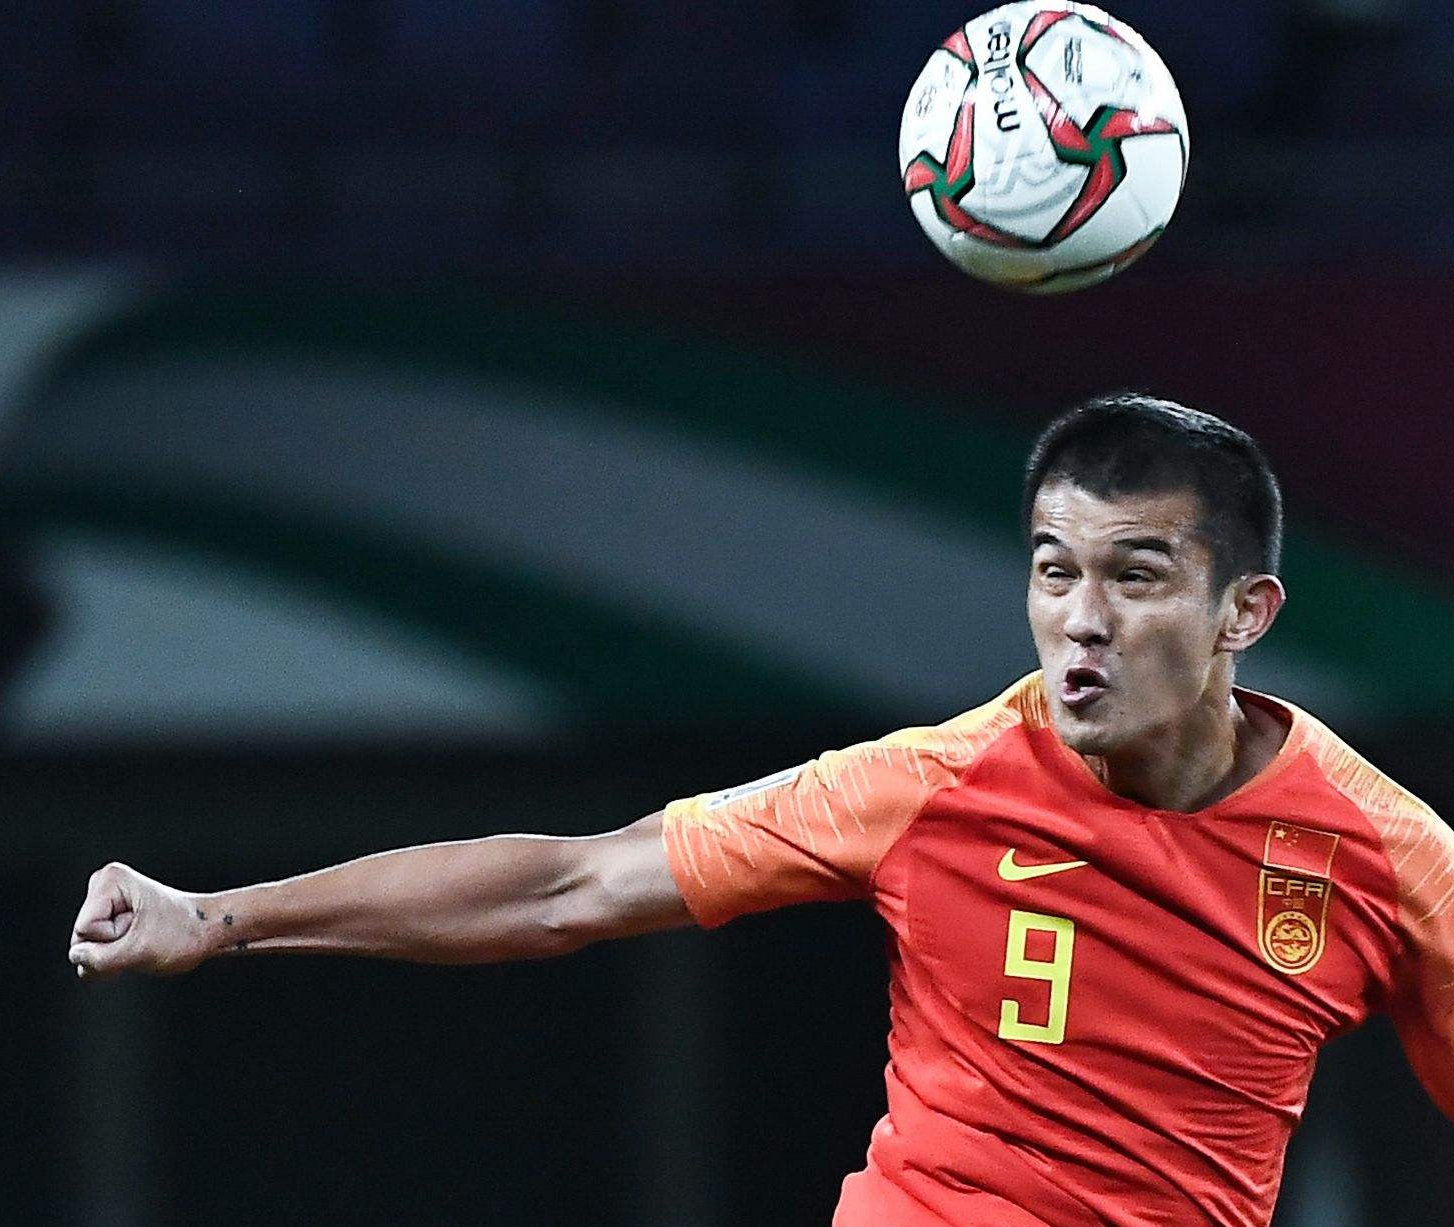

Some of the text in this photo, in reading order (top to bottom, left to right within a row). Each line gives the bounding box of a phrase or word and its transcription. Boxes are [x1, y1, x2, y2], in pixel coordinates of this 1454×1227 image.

[984, 20, 1021, 132] molten
[1266, 877, 1324, 898] CFA
[998, 909, 1075, 1045] 9
